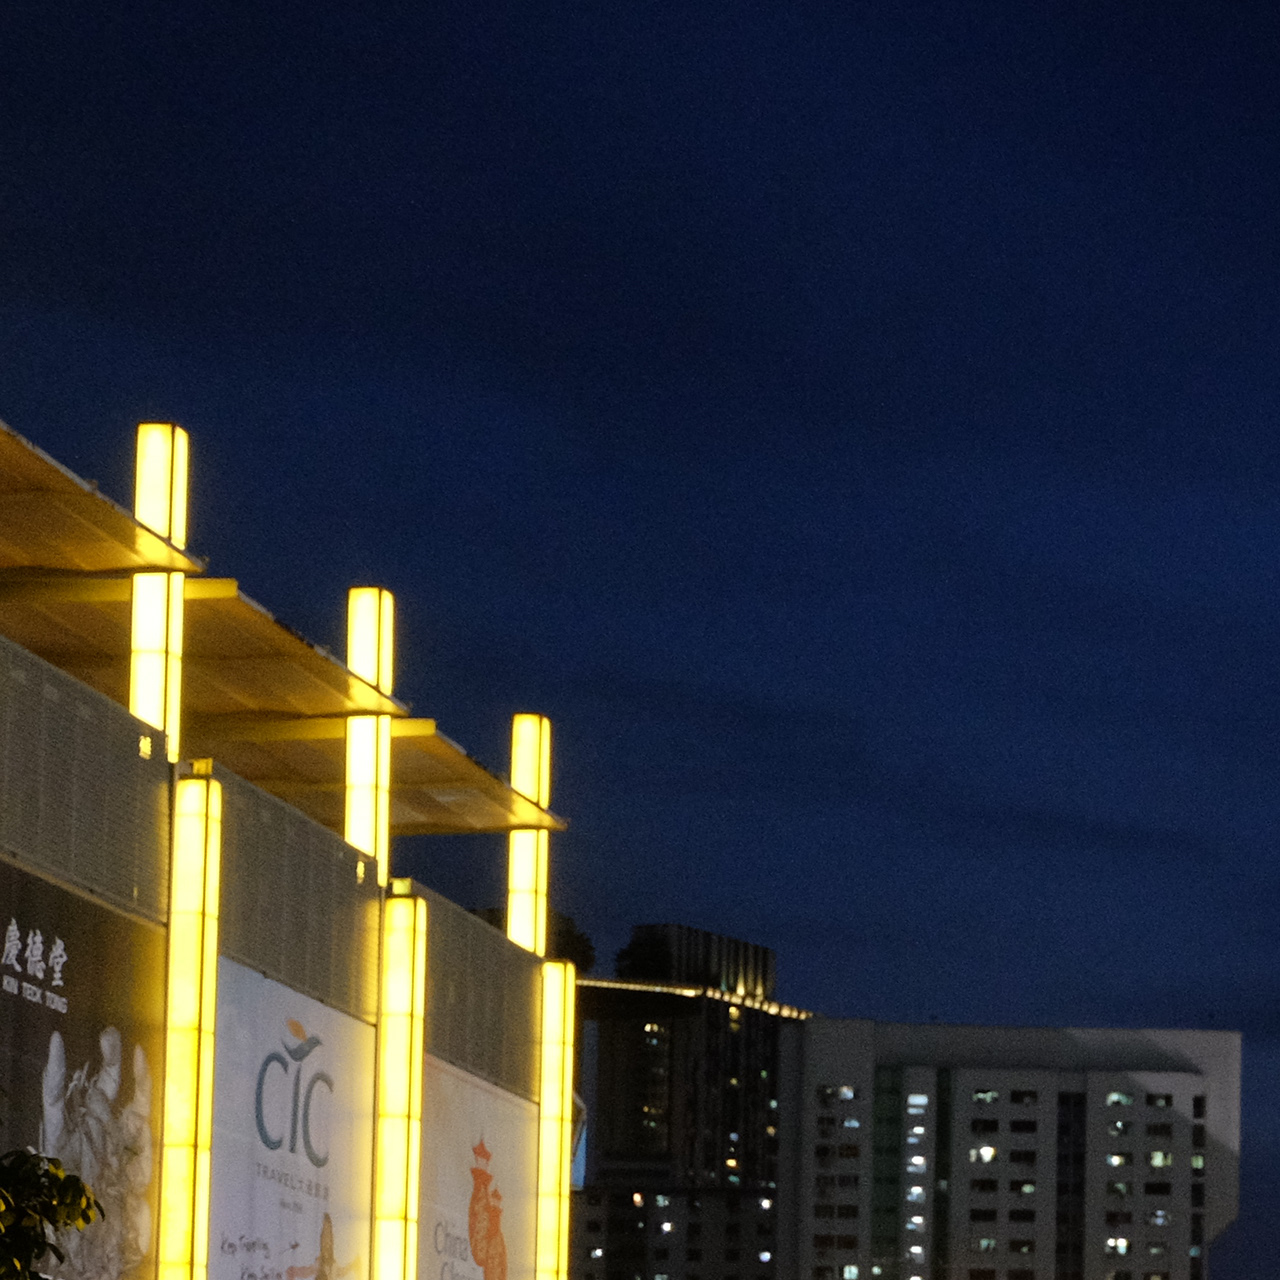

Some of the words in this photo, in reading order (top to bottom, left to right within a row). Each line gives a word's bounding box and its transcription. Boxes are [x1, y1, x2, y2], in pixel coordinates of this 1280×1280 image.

[254, 1051, 335, 1168] CIC
[256, 1162, 297, 1191] TRAVEL
[433, 1220, 470, 1262] China
